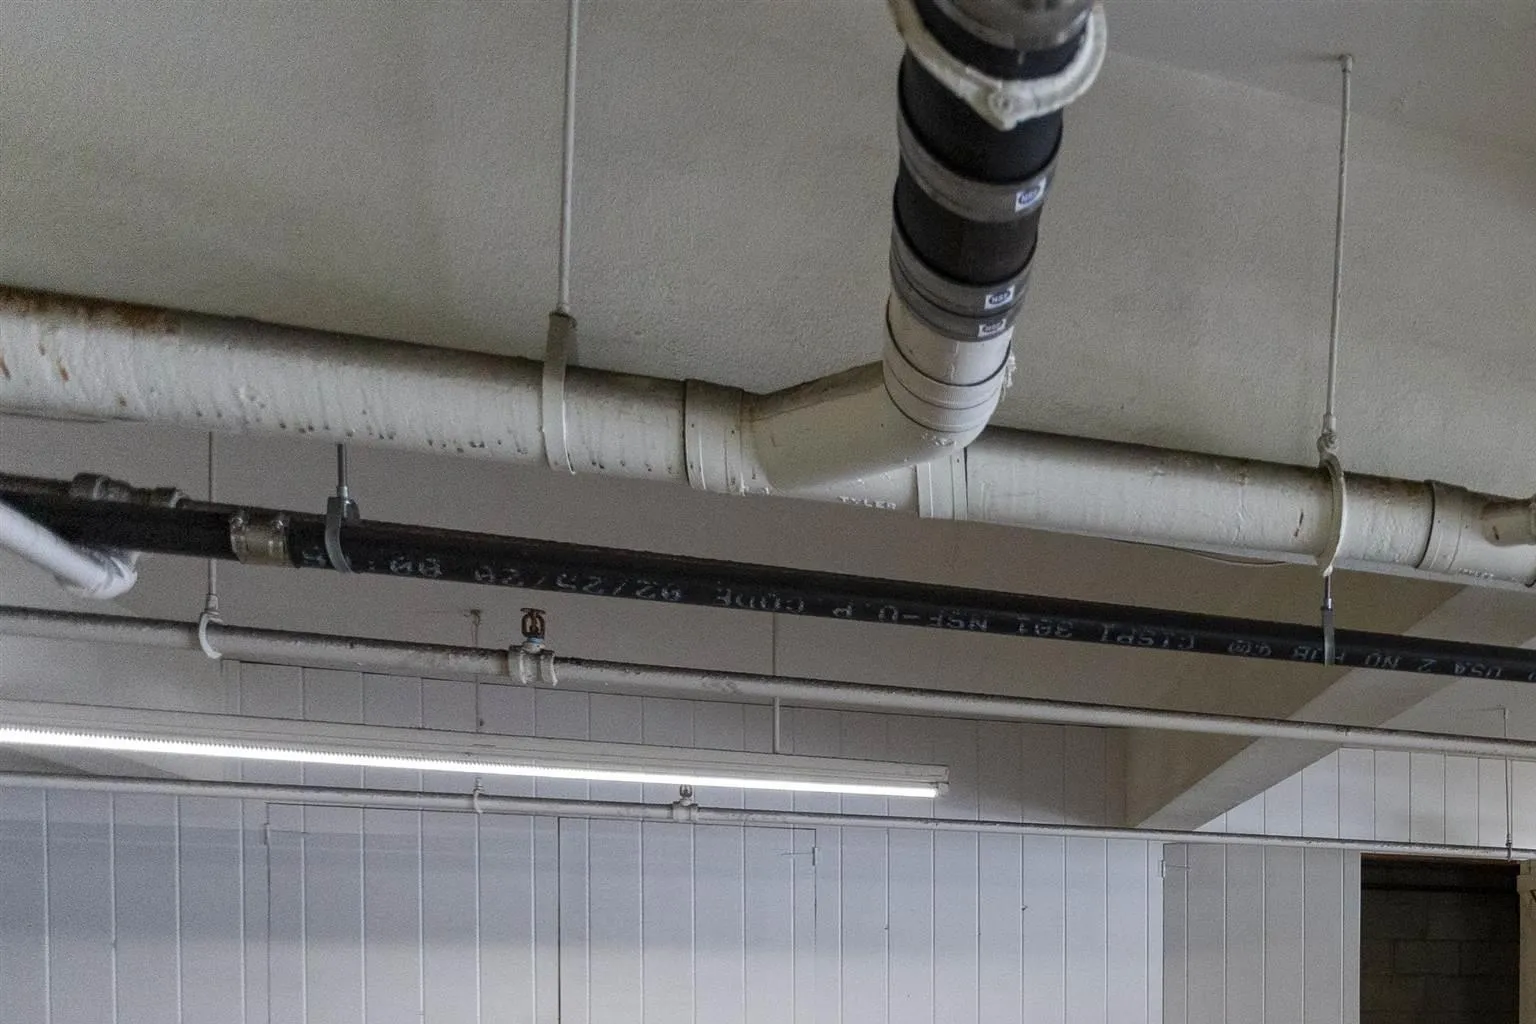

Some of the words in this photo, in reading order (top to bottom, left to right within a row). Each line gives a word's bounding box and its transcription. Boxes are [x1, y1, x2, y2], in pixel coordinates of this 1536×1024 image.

[838, 495, 897, 510] TYLER
[1364, 651, 1399, 670] NO
[1417, 657, 1436, 673] 2
[1452, 660, 1502, 680] USA
